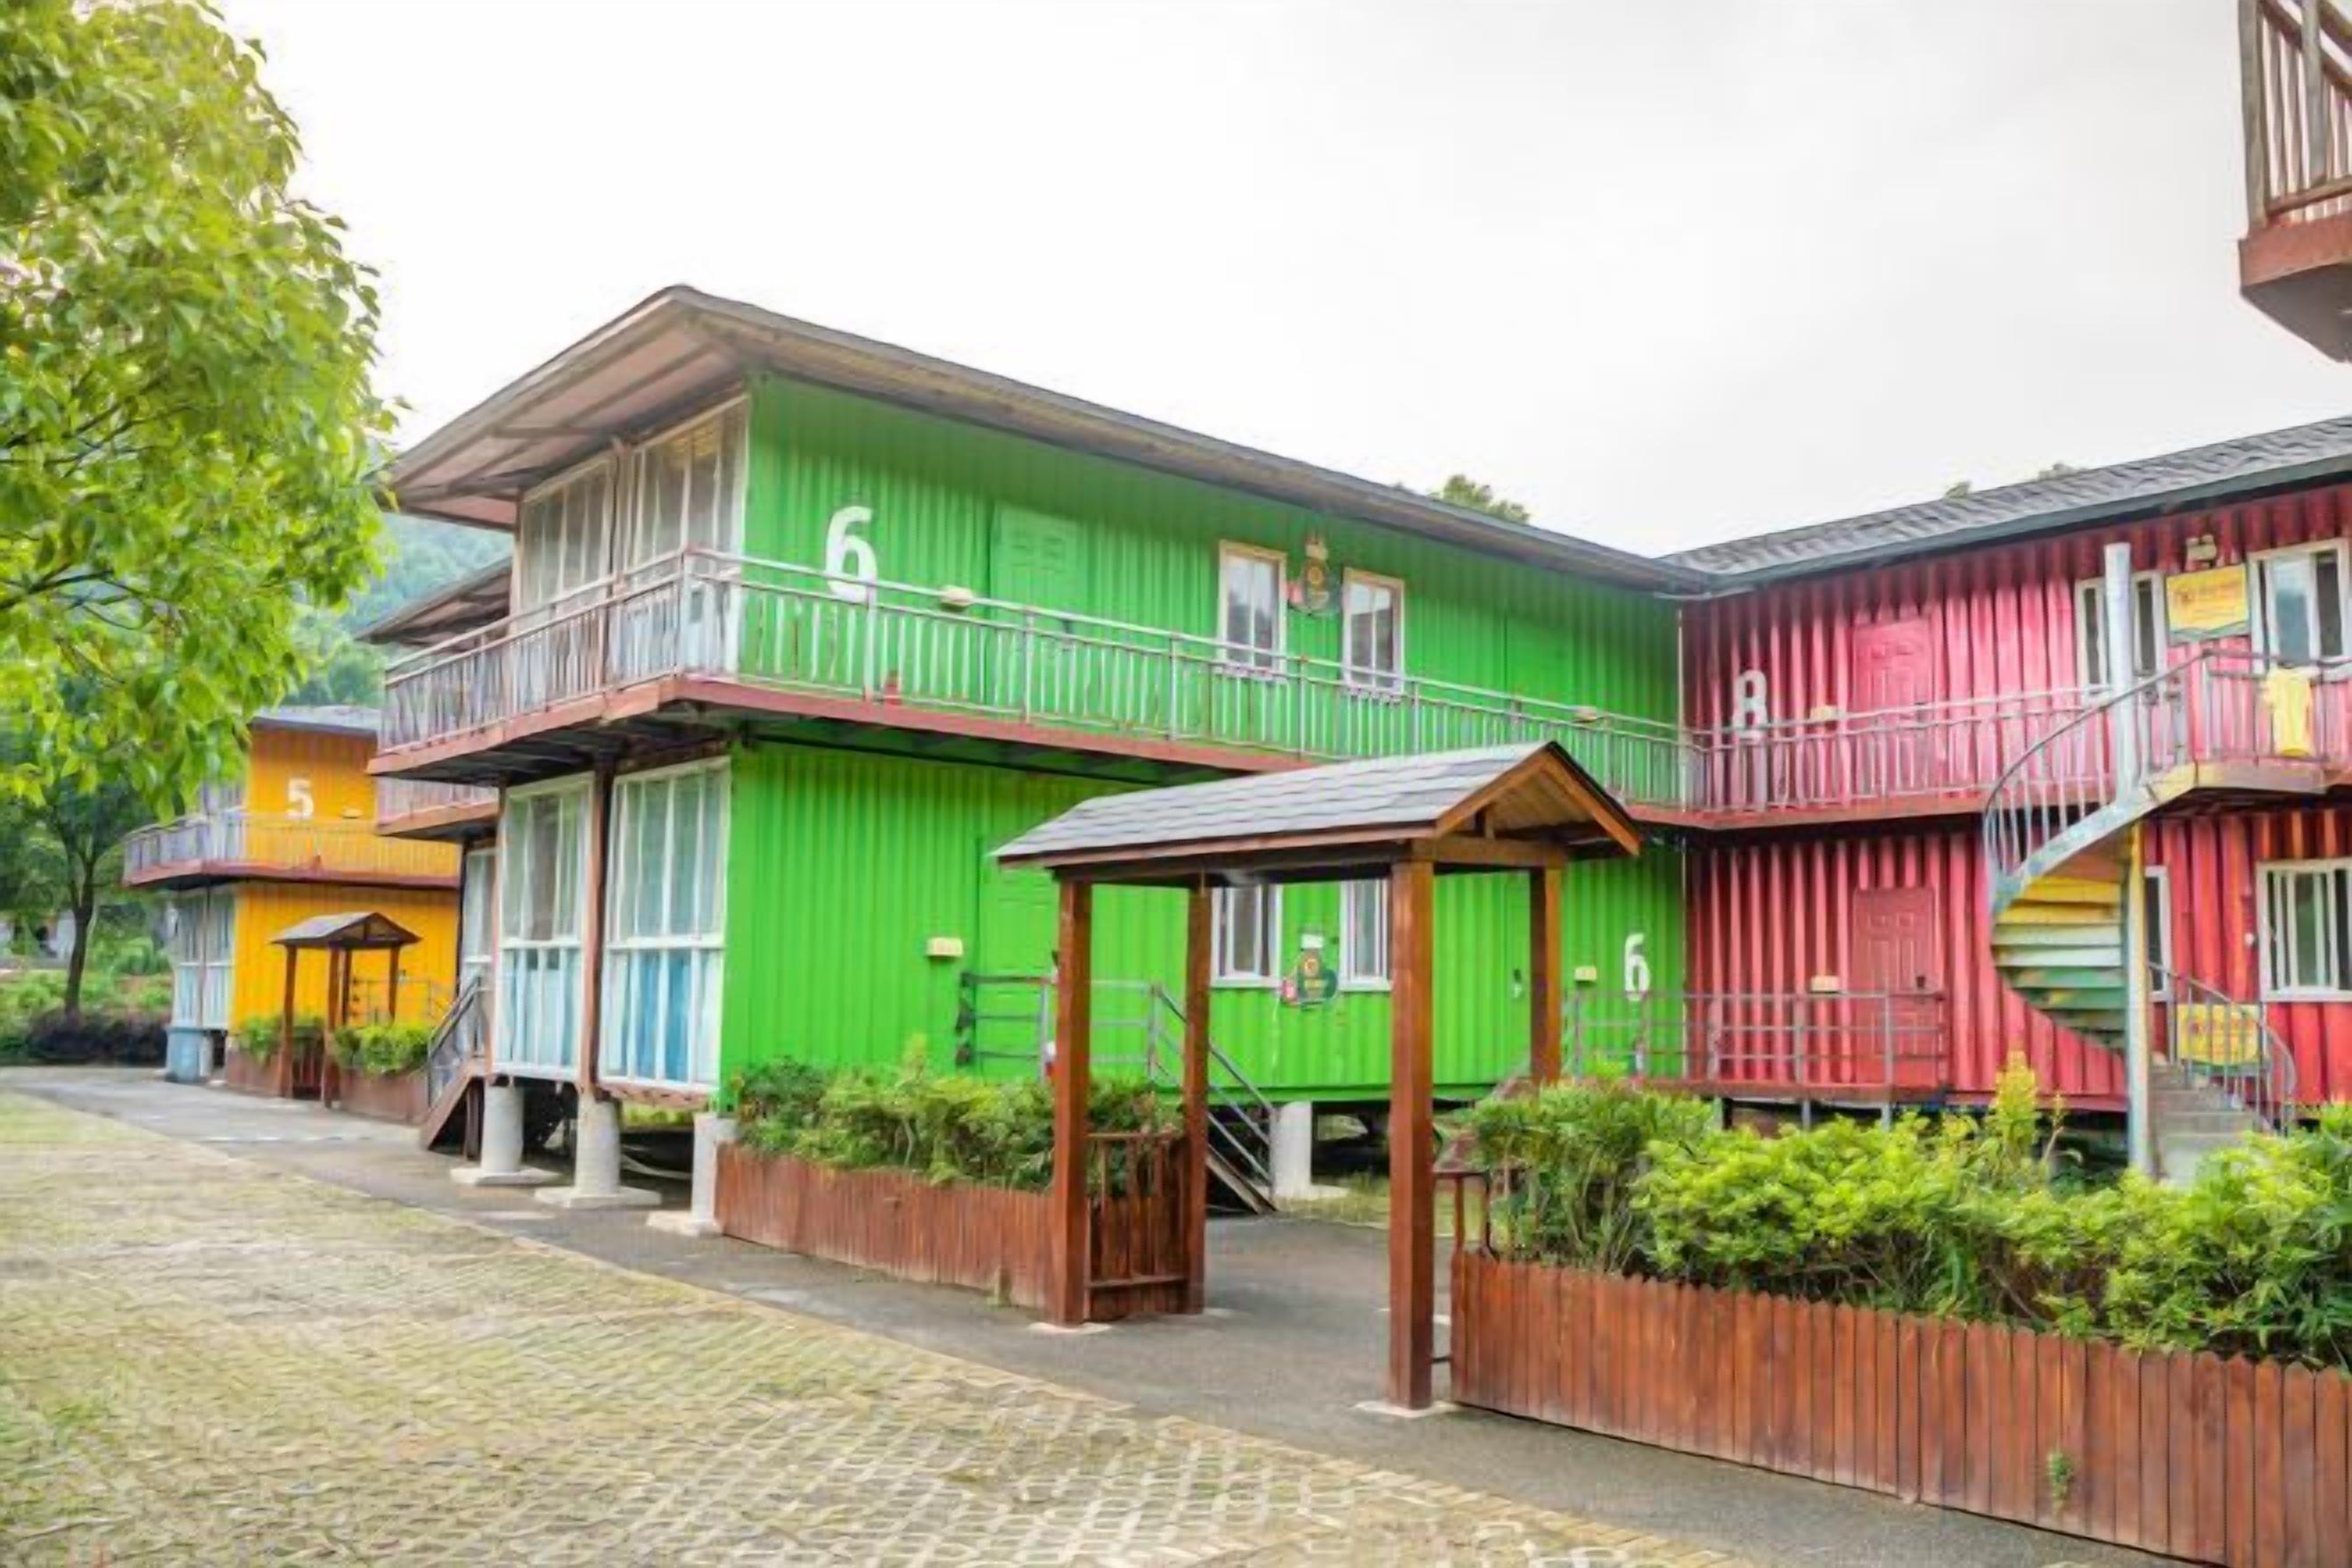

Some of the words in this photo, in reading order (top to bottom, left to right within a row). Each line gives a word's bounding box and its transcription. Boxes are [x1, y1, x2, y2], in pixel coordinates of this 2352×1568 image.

[826, 506, 877, 603] 6
[1733, 669, 1768, 739] 8
[287, 778, 314, 820] 5
[1624, 934, 1651, 1001] 6
